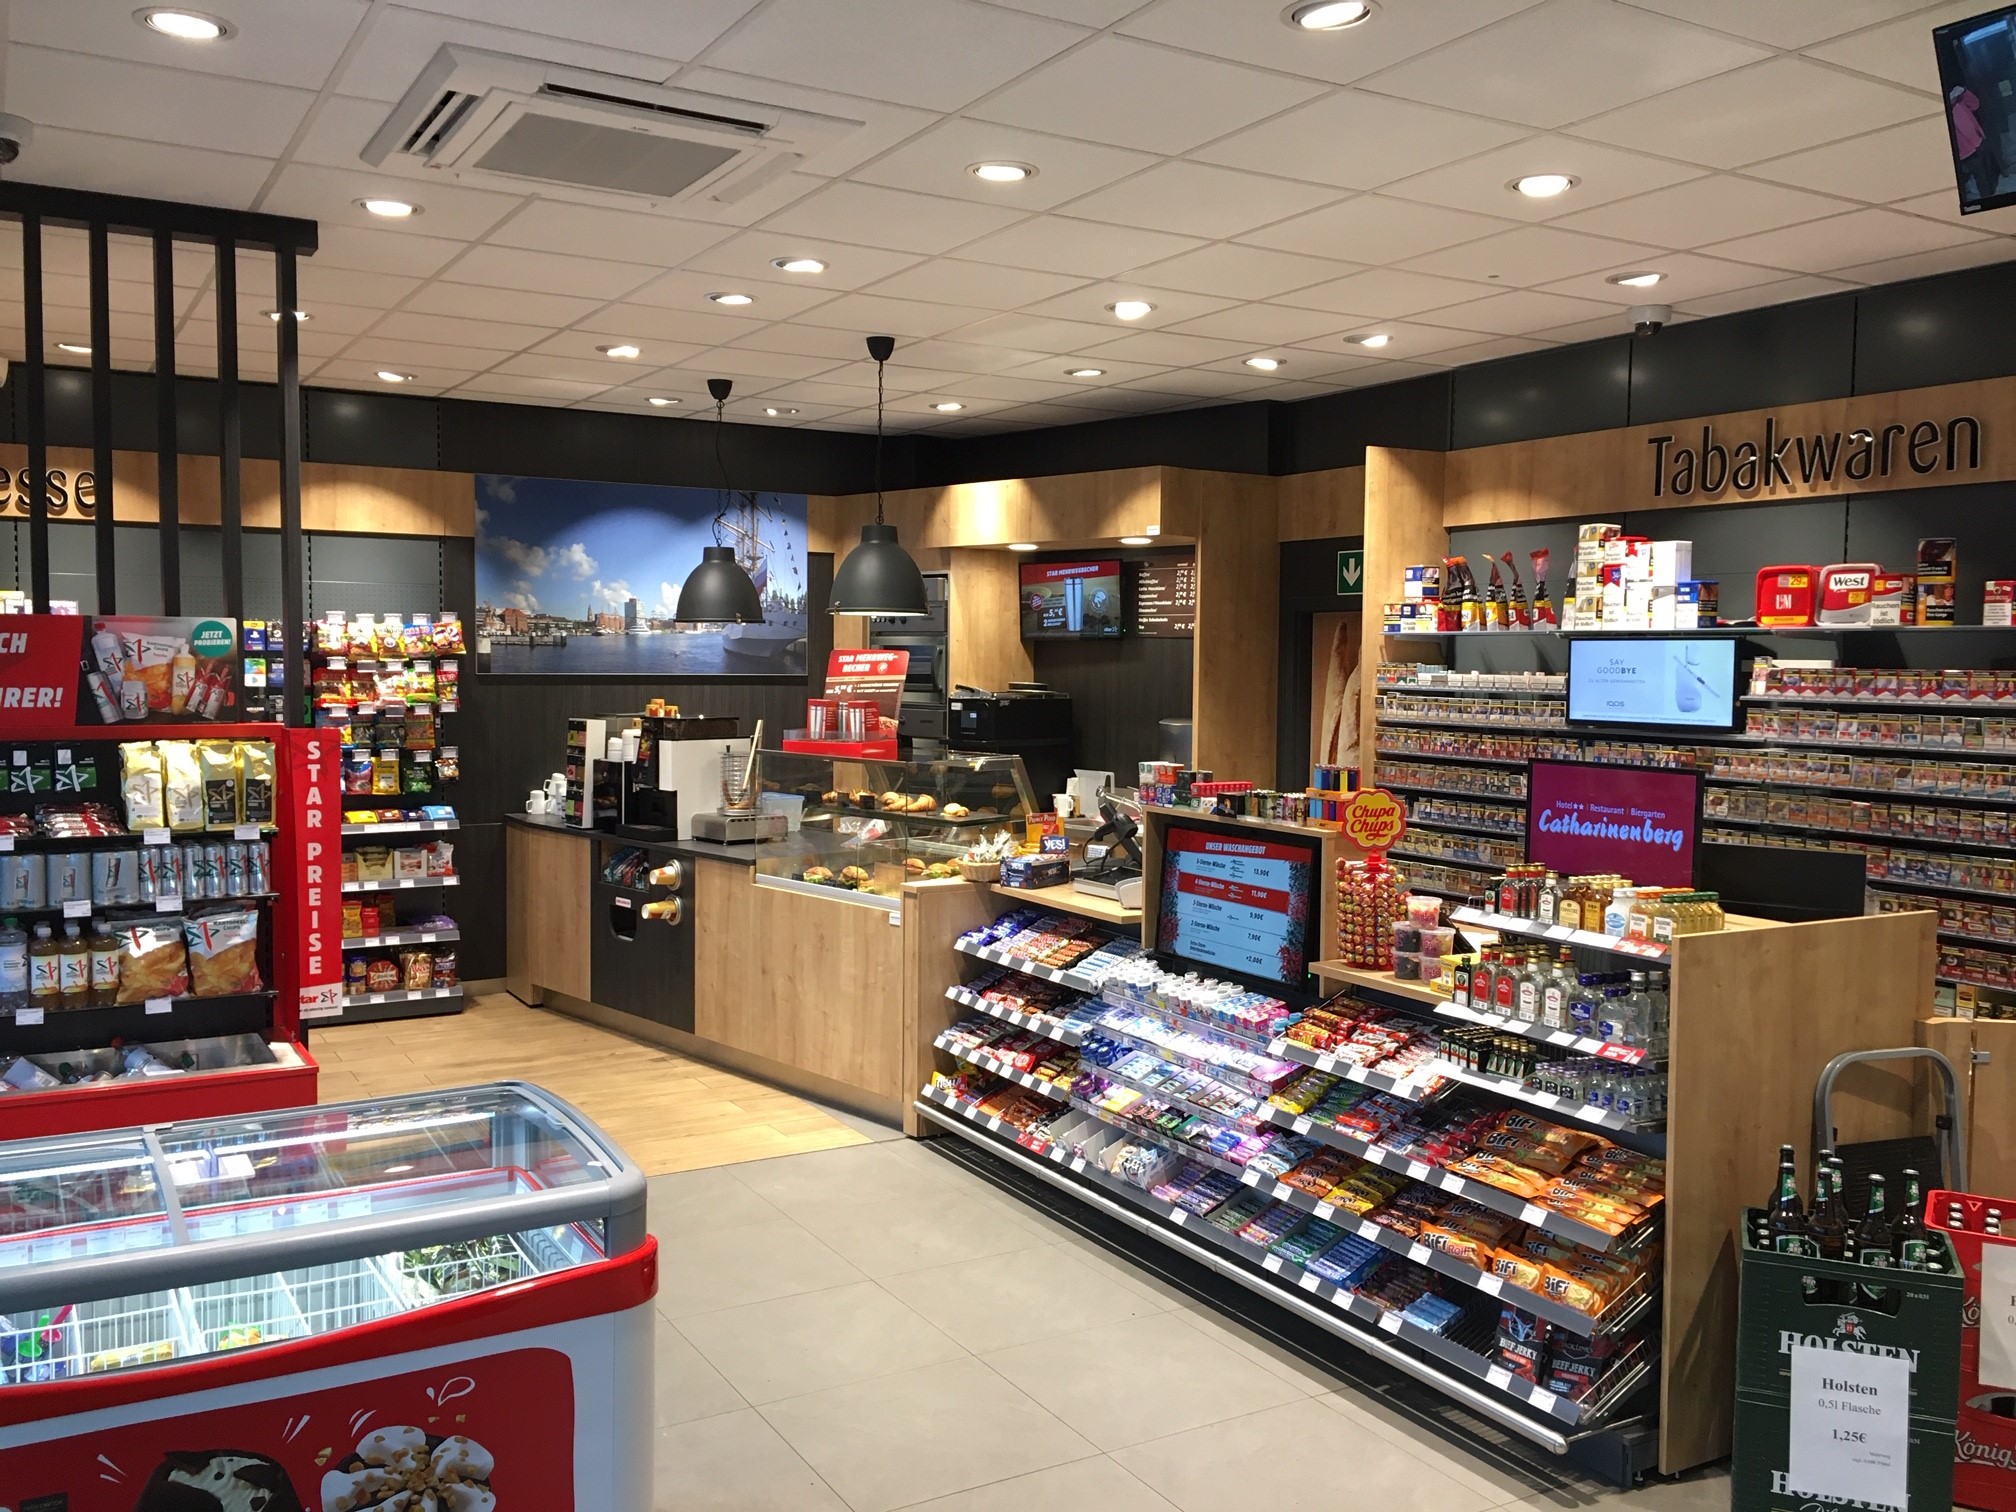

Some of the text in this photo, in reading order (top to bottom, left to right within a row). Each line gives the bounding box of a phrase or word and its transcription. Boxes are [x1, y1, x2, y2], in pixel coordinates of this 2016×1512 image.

[1647, 416, 1981, 498] Tabakwaren
[1833, 576, 1865, 587] West
[200, 630, 223, 639] JETZT
[1597, 666, 1637, 674] GOODBYE
[0, 687, 63, 708] RER!
[1352, 804, 1396, 819] Chupa
[1556, 800, 1666, 819] Hotel Restaurant Biergarten
[1350, 819, 1394, 840] Chups
[1538, 808, 1684, 852] Catharinenberg
[1044, 838, 1066, 851] YES!
[1205, 841, 1266, 854] UNSER WASCHANGEBOT
[306, 741, 323, 975] STAR PREISE
[1253, 868, 1270, 877] 13,90€
[1251, 890, 1268, 899] 11,90€
[1249, 912, 1264, 920] 9,90€
[1247, 932, 1262, 942] 7,90€
[299, 995, 318, 1004] tar
[1423, 1233, 1468, 1256] BiFi Roll
[1495, 1258, 1518, 1275] BiFi
[1545, 1275, 1571, 1295] BiFi
[1499, 1337, 1514, 1351] BEEF
[1514, 1343, 1538, 1360] JERKY
[1552, 1359, 1569, 1371] BEEF
[1569, 1363, 1596, 1377] JERKY
[1822, 1377, 1878, 1396] Holsten
[1841, 1401, 1881, 1415] Flasche
[1832, 1428, 1868, 1443] 1,25€
